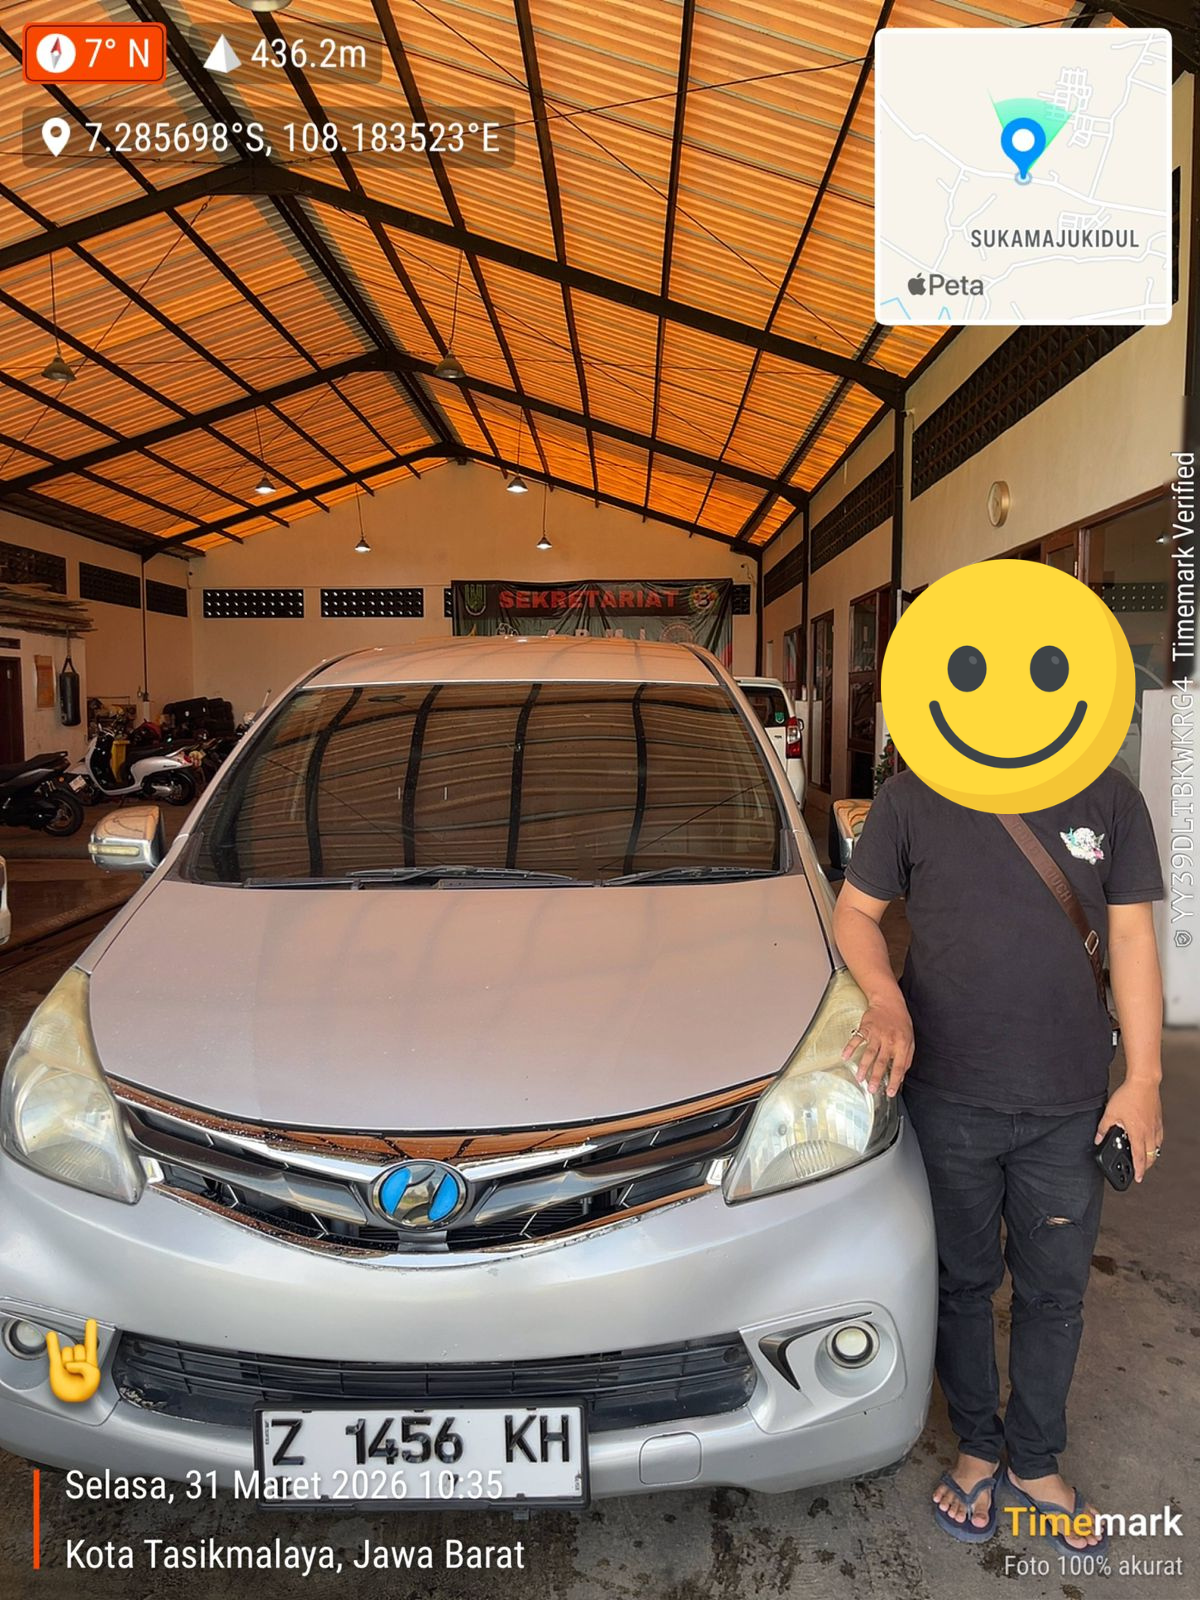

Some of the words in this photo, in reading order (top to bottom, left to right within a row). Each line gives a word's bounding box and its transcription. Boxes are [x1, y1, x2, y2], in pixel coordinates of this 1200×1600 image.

[498, 589, 679, 609] SEKRETARIAT
[271, 1417, 305, 1465] Z
[345, 1416, 464, 1466] 1456
[504, 1414, 571, 1464] KH
